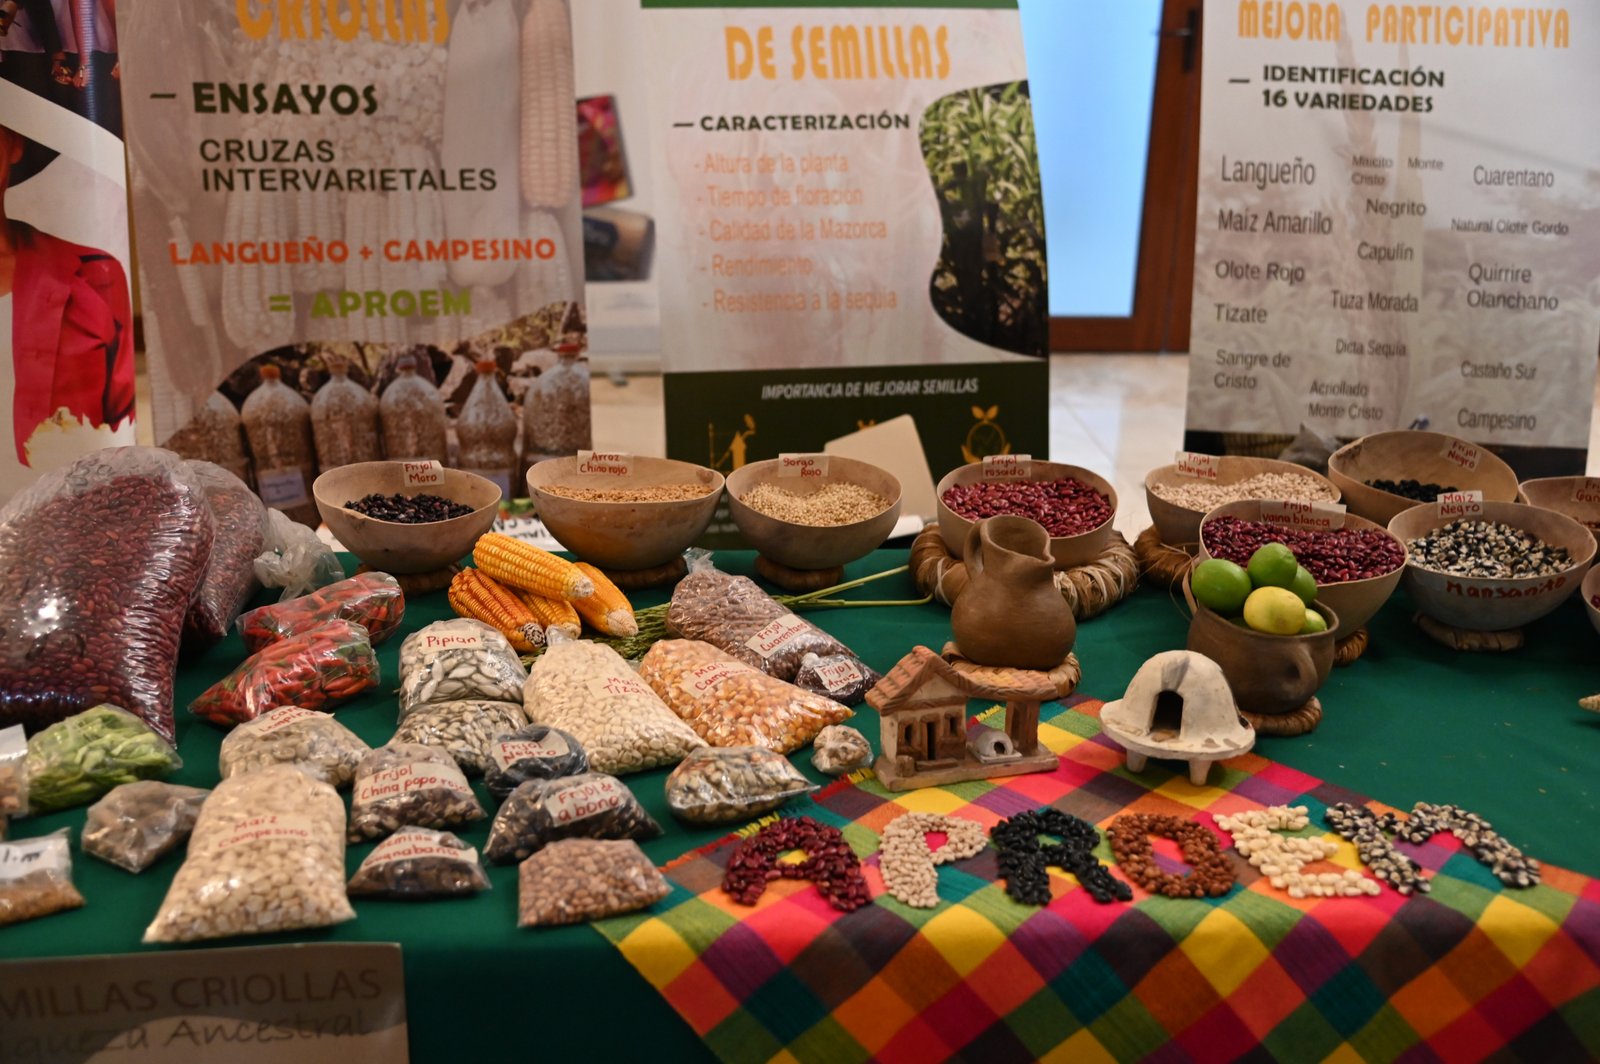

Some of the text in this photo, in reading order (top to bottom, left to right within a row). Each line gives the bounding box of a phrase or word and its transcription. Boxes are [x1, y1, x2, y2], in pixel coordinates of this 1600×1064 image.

[235, 0, 450, 44] CRIOLLAS
[1238, 0, 1571, 49] MEJORA PARTICIPATIVA
[724, 24, 951, 80] DE SEMILLAS
[1263, 64, 1445, 88] IDENTIFICACIÓN
[192, 82, 378, 116] ENSAYOS
[1263, 90, 1434, 113] 16 VARIEDADES
[700, 110, 910, 132] CARACTERIZACIÓN
[200, 139, 335, 163] CRUZAS
[703, 152, 849, 177] Altura de la planta
[1221, 155, 1316, 190] Langueño
[1407, 157, 1444, 171] Monte
[1473, 164, 1555, 188] Cuarentano
[202, 168, 497, 192] INTERVARIETALES
[706, 184, 766, 211] Tiempo
[770, 184, 792, 207] de
[1366, 198, 1427, 219] Negrito
[709, 217, 888, 242] Calidad de la Mazorca
[1263, 210, 1333, 235] Amarillo
[1451, 218, 1569, 236] Natural Olote Gordo
[169, 236, 349, 265] LANGUEÑO
[383, 238, 556, 262] CAMPESINO
[712, 253, 813, 277] Rendimiento
[1215, 260, 1306, 286] Olote Rojo
[1468, 262, 1532, 286] Quirrire
[310, 289, 471, 318] APROEM
[714, 288, 806, 313] Resistencia
[811, 293, 821, 311] a
[827, 290, 841, 311] la
[1331, 289, 1419, 313] Tuza Morada
[1467, 288, 1559, 311] Olanchano
[1214, 302, 1268, 324] Tizate
[1215, 348, 1292, 371] Sangre de
[1214, 371, 1258, 390] Cristo
[1515, 363, 1538, 381] Sur
[761, 378, 979, 399] IMPORTANCIA DE MEJORAR SEMILLAS
[1308, 402, 1384, 420] Monte Cristo
[1457, 407, 1538, 433] Campesino
[404, 461, 433, 474] Frijol
[591, 452, 620, 461] Arroz
[1447, 450, 1475, 469] Negro
[409, 473, 438, 483] Moro
[985, 466, 1025, 477] rosado
[1283, 501, 1312, 513] Frijol
[1440, 503, 1480, 516] Negro
[426, 634, 477, 648] Pipian
[503, 749, 557, 765] Negro
[374, 765, 413, 783] Frijol
[170, 968, 383, 1009] CRIOLLAS
[163, 1008, 371, 1047] Ancestral
